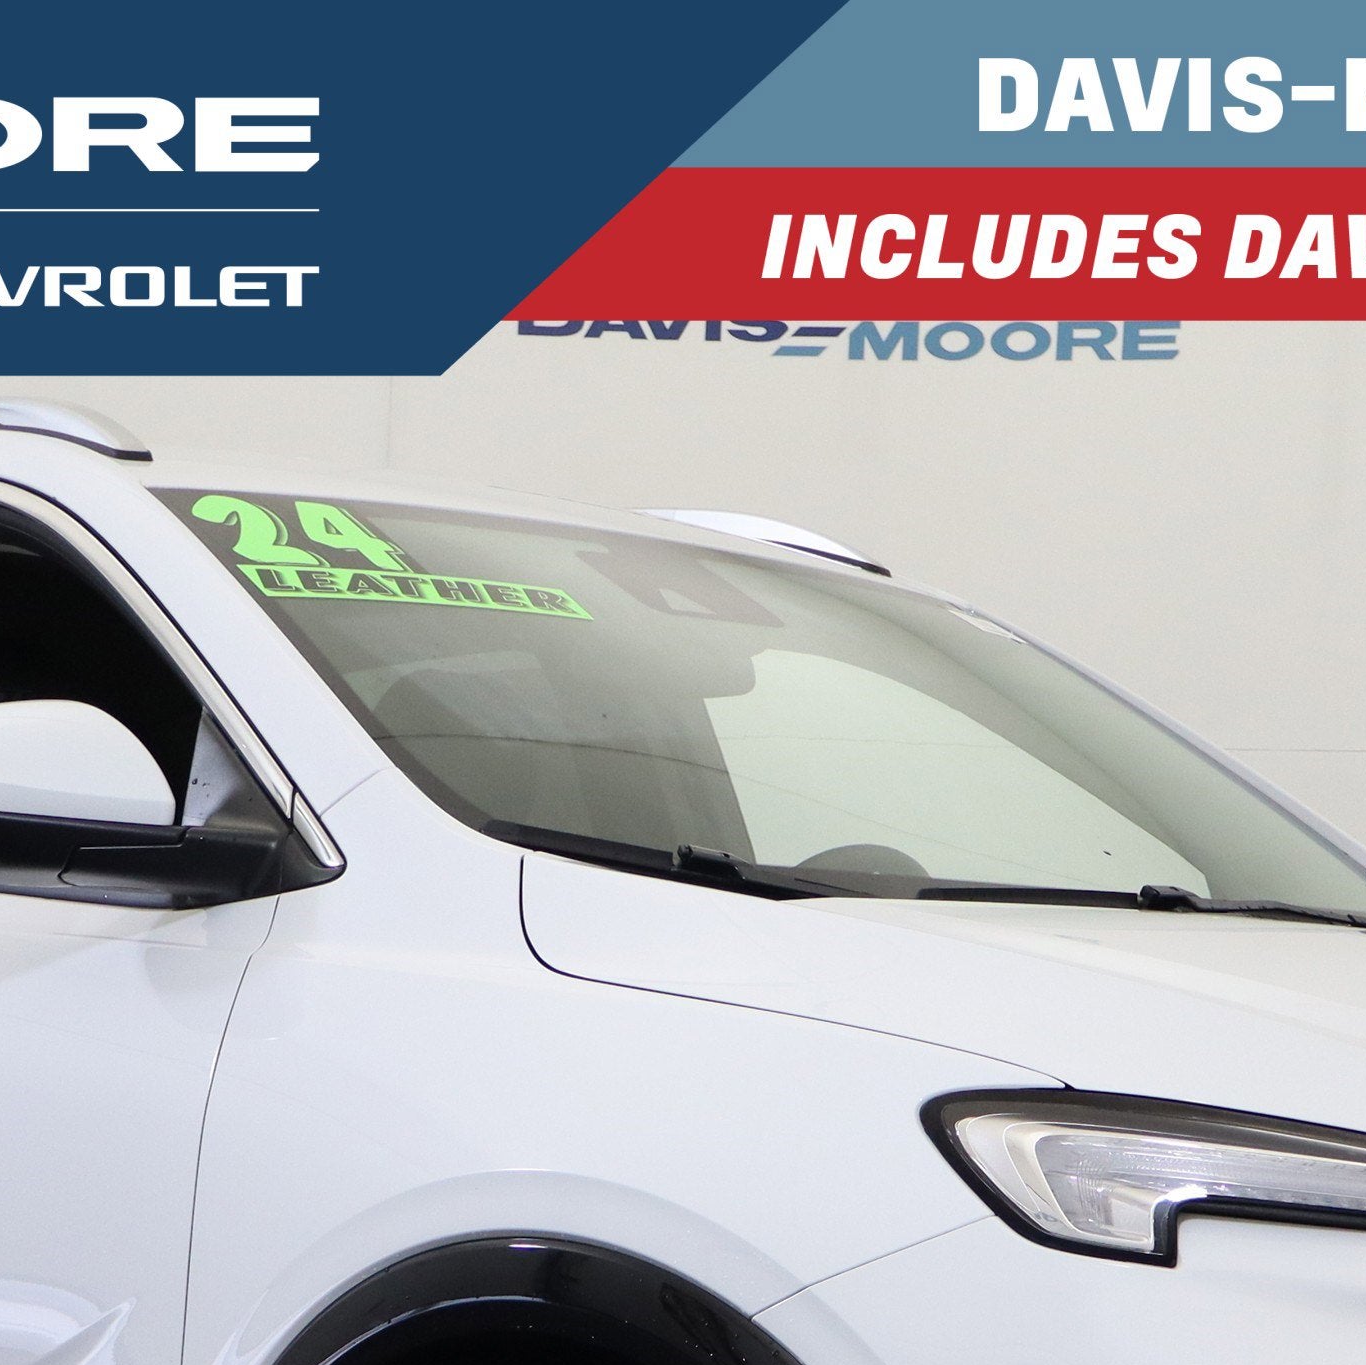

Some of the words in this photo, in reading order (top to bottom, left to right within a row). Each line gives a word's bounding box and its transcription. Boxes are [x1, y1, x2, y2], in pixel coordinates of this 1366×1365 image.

[848, 321, 1181, 361] MOORE
[191, 494, 413, 573] 24
[252, 567, 575, 614] LEATHER
